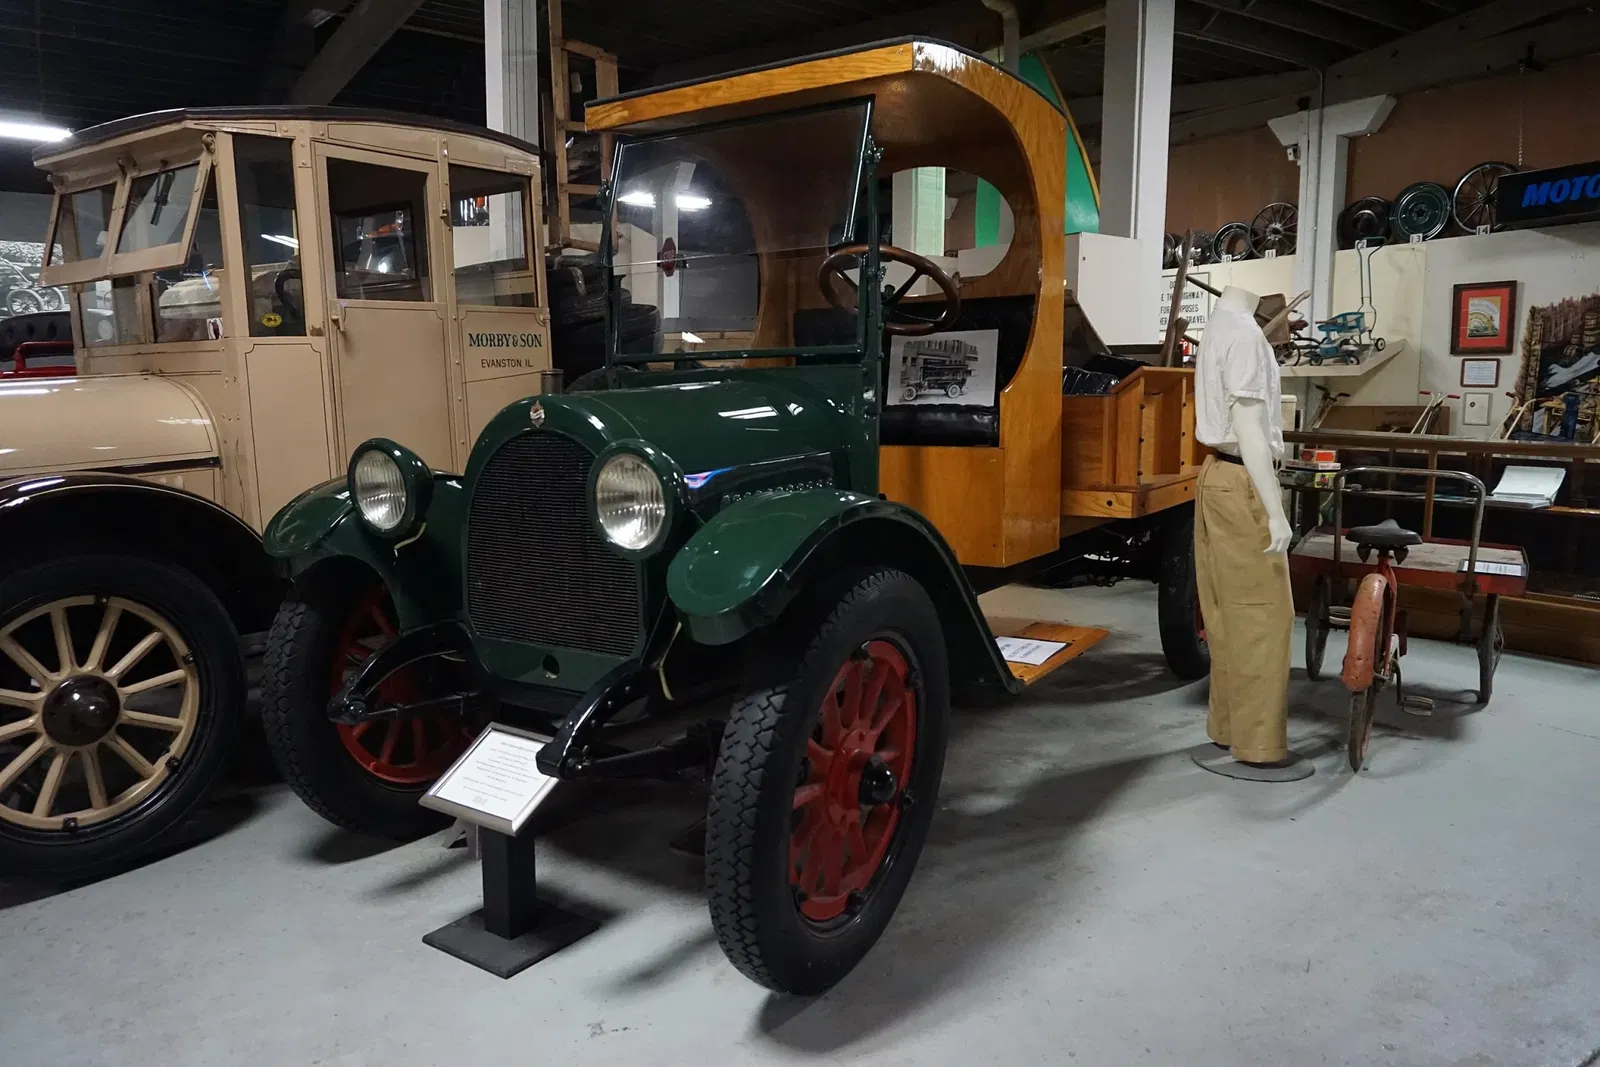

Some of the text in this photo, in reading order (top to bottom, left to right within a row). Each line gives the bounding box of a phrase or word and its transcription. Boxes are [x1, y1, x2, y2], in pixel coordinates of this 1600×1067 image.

[1477, 227, 1488, 235] 14
[1411, 235, 1421, 243] 13
[468, 333, 511, 348] MORBY
[519, 333, 542, 348] SON
[481, 358, 522, 368] EVANSTON
